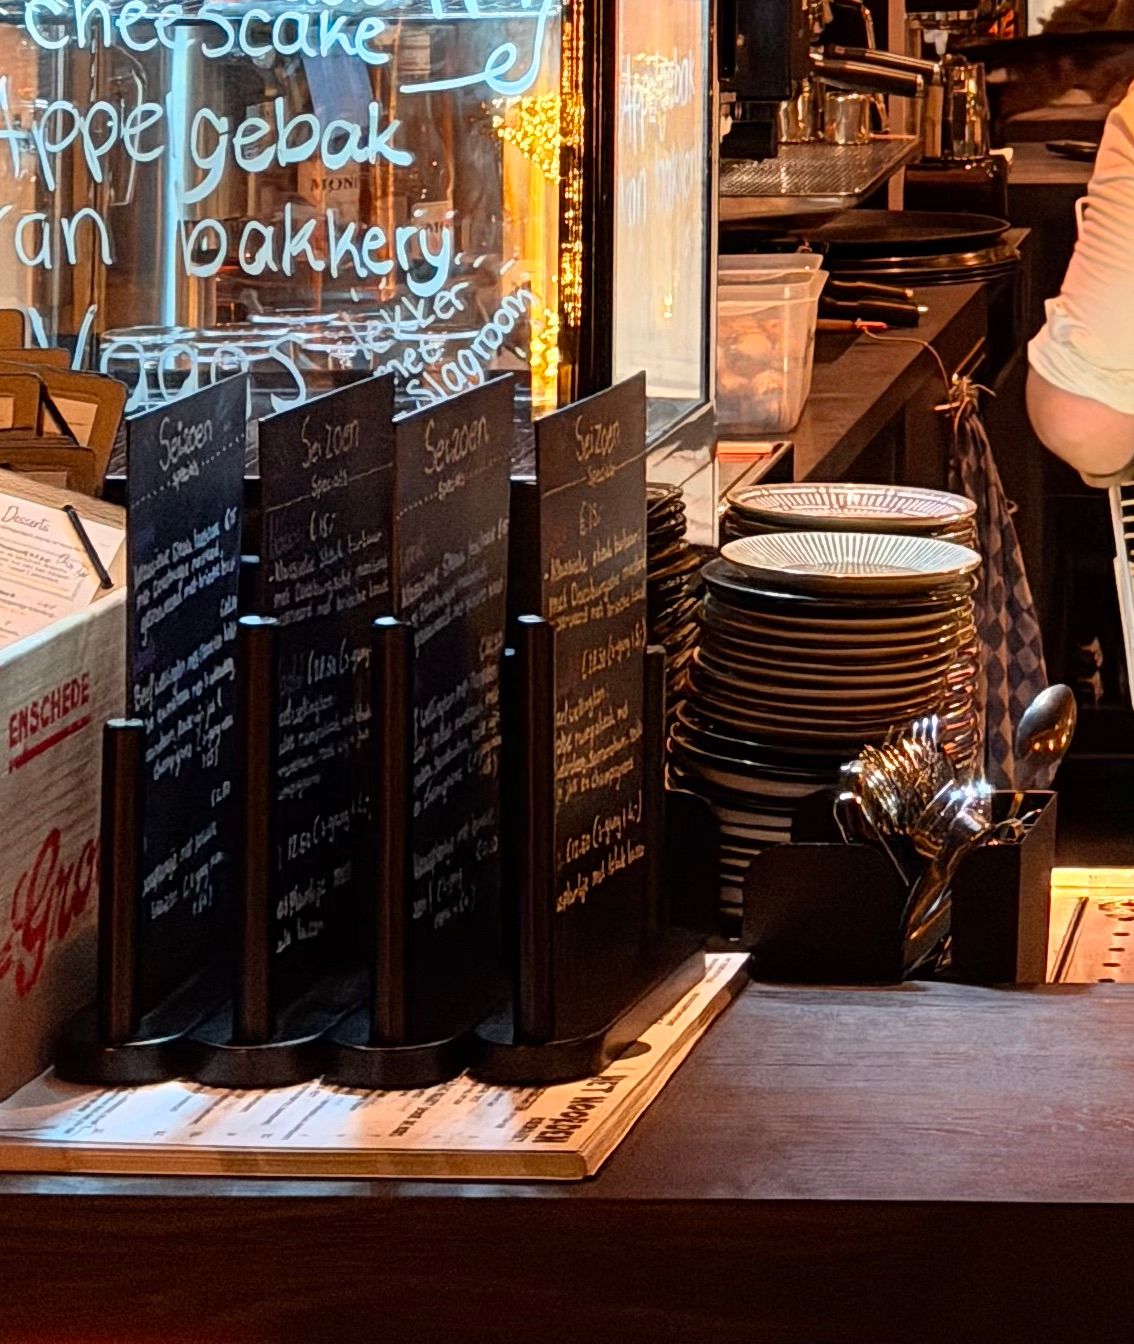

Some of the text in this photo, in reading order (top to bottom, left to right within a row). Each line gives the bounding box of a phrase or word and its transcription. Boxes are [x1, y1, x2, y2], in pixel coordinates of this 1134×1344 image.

[159, 417, 213, 472] Seizoen
[424, 416, 489, 474] Seizoen
[575, 414, 621, 462] Seizoen
[8, 671, 91, 750] ENSCHEDE
